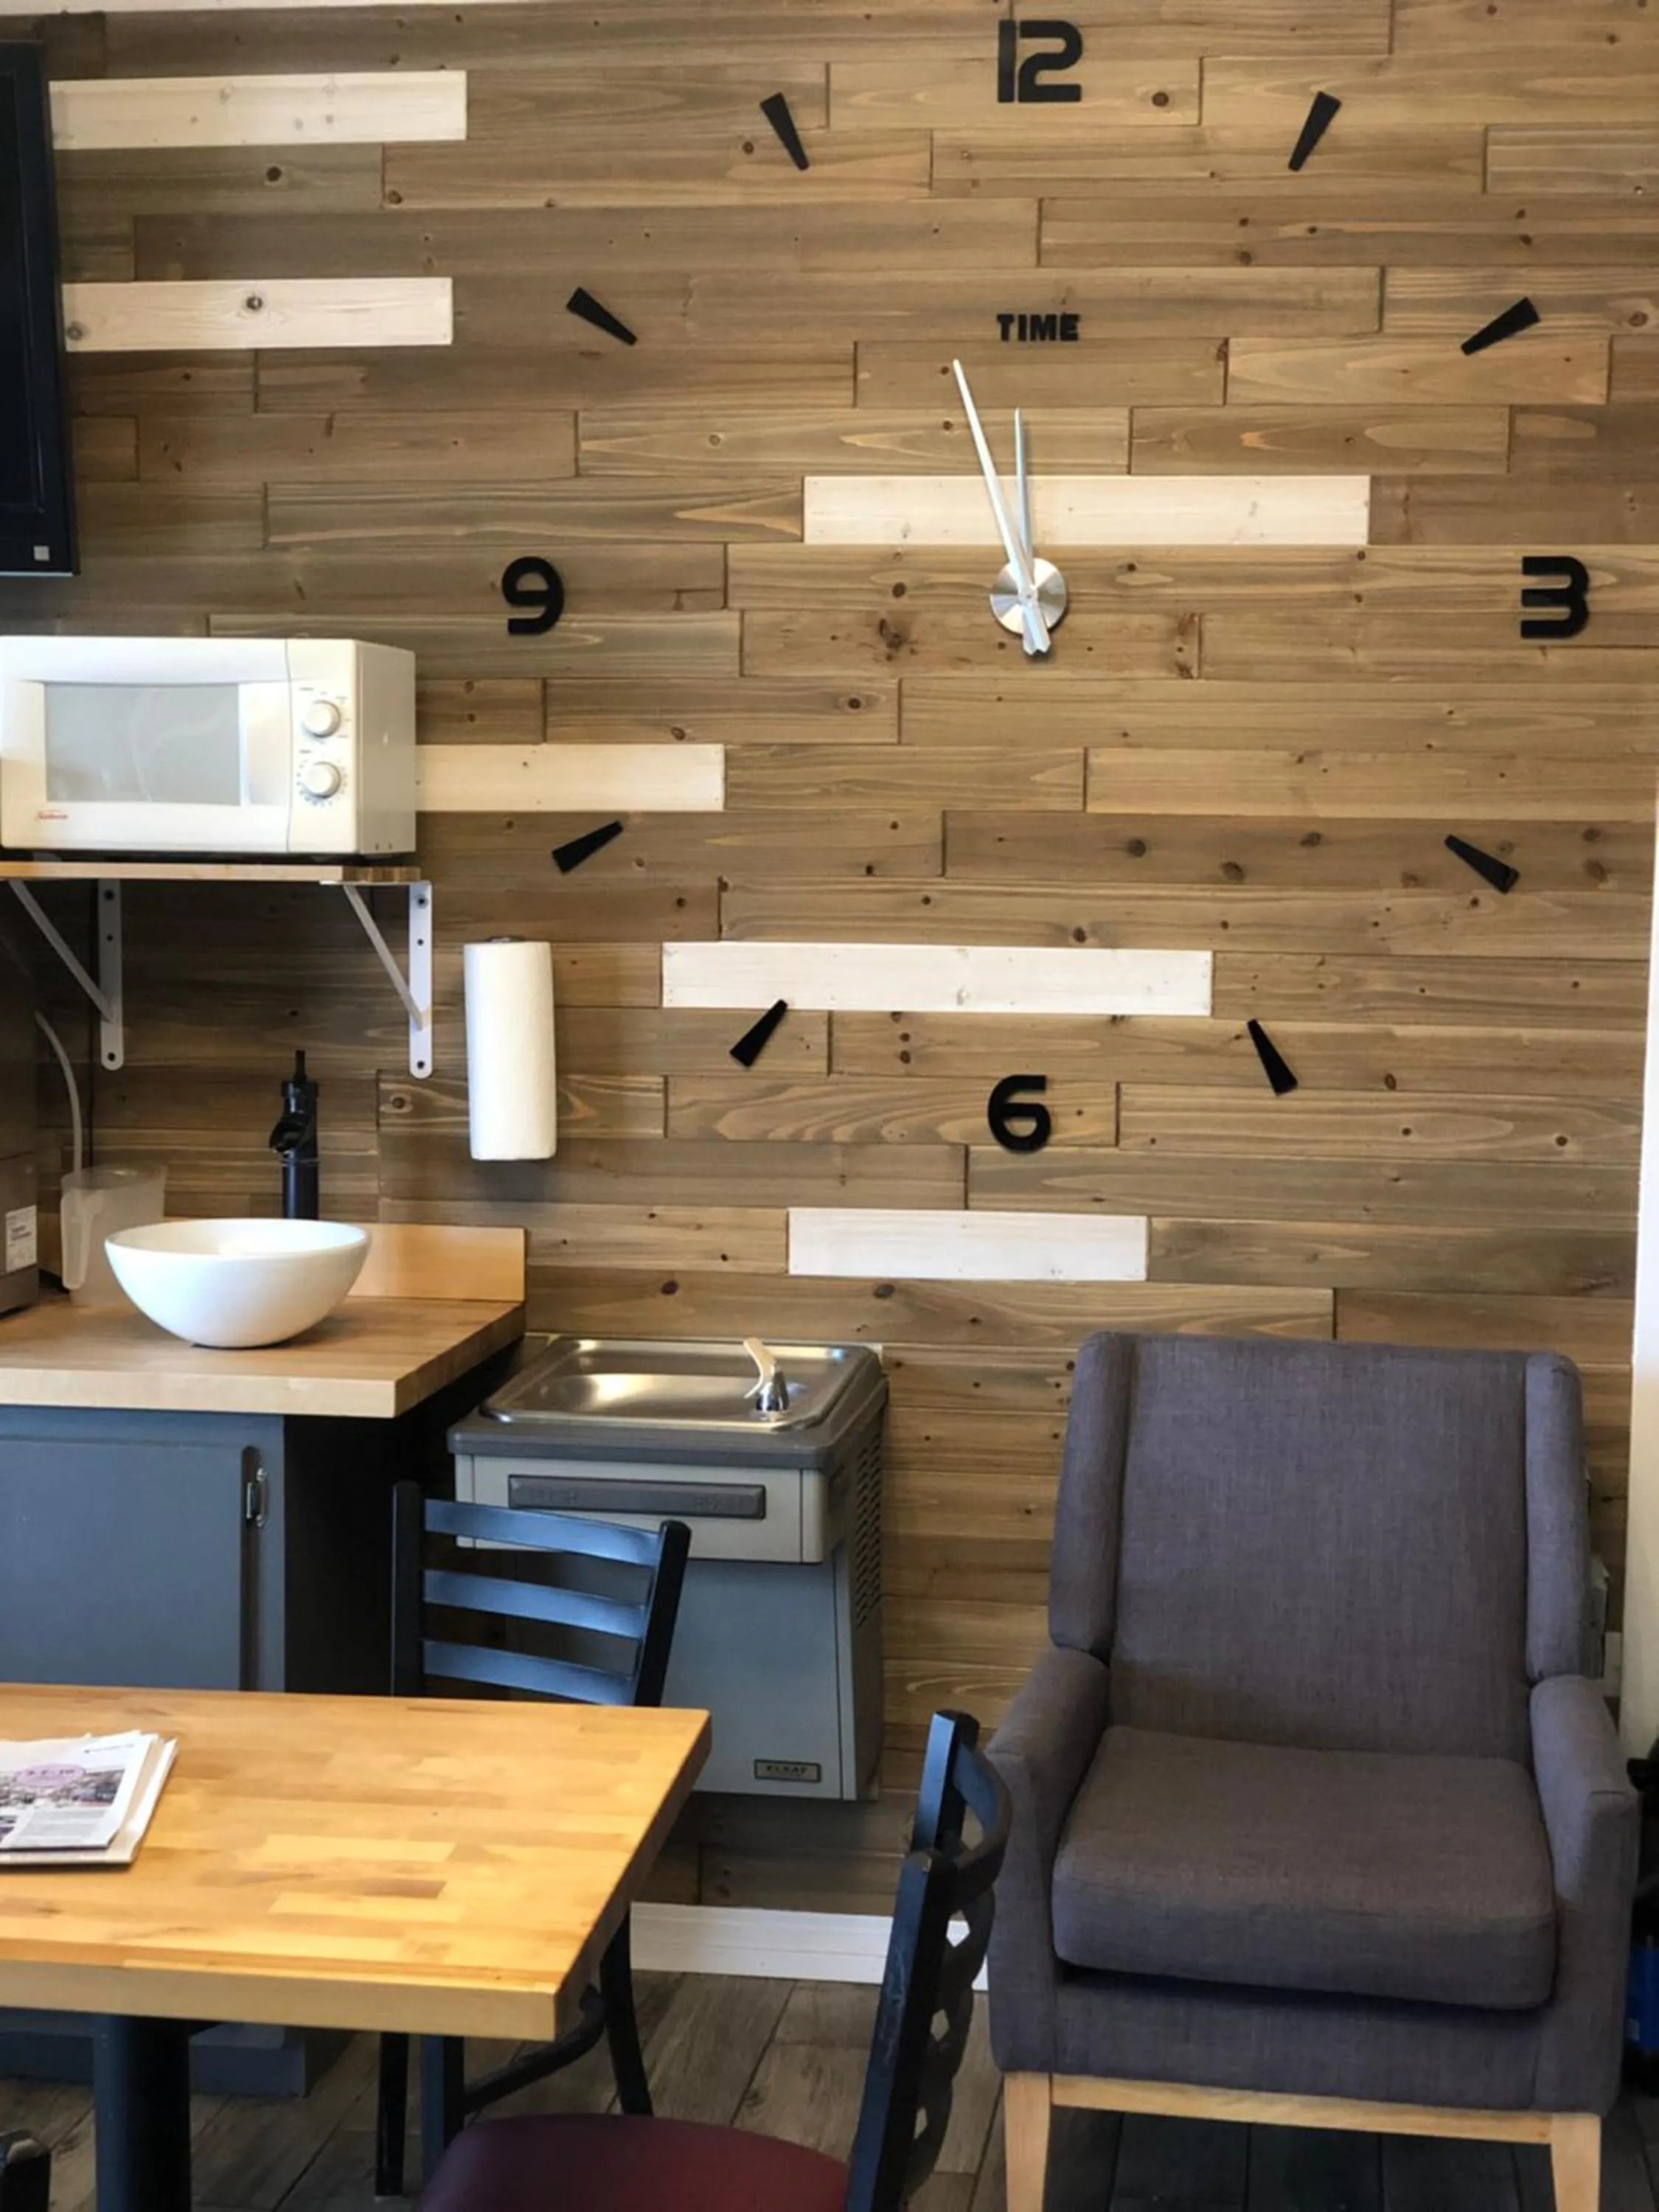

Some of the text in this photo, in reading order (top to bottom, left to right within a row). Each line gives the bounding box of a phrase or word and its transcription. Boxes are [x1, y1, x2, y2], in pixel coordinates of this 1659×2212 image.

[998, 19, 1082, 102] 12
[996, 313, 1080, 342] TIME
[501, 556, 565, 636] 9
[1520, 555, 1589, 639] 3
[987, 1074, 1051, 1155] 6
